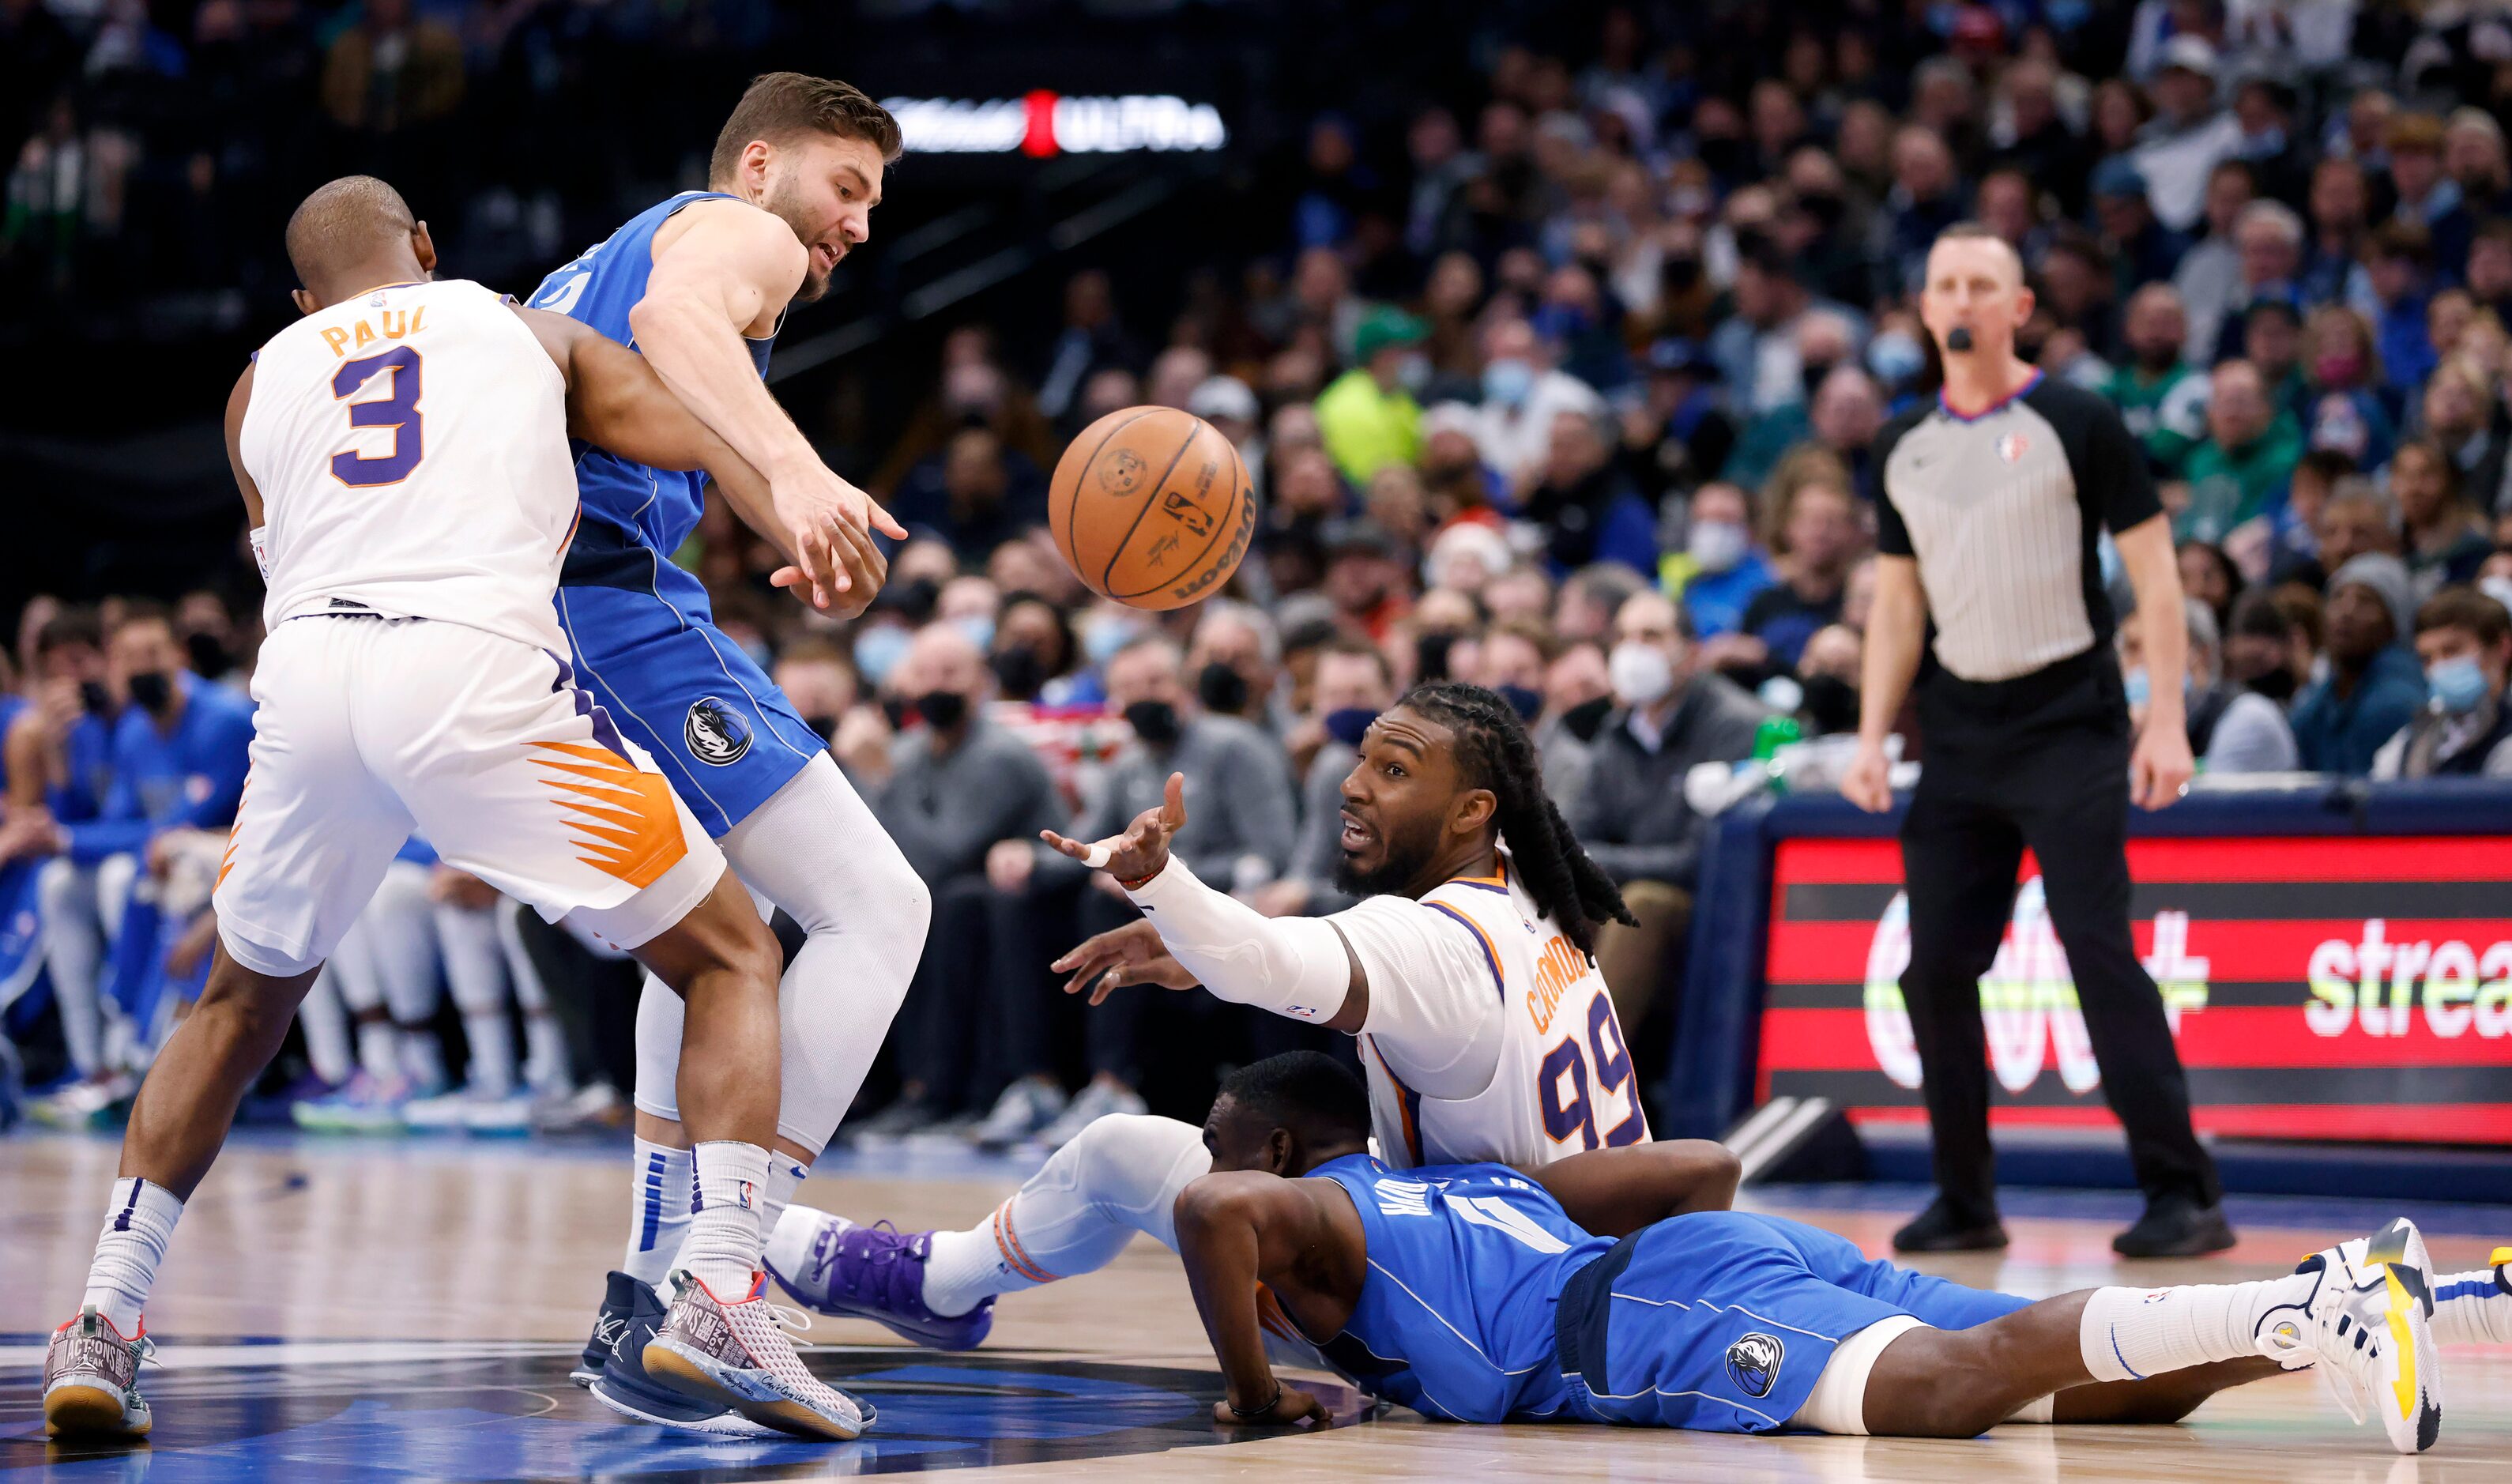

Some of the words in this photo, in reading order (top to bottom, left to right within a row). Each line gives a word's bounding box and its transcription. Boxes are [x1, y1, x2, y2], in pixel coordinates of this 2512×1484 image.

[320, 305, 428, 358] PAUL
[330, 345, 424, 488] 3
[1537, 989, 1644, 1151] 99
[66, 1338, 115, 1372] ACTIONS
